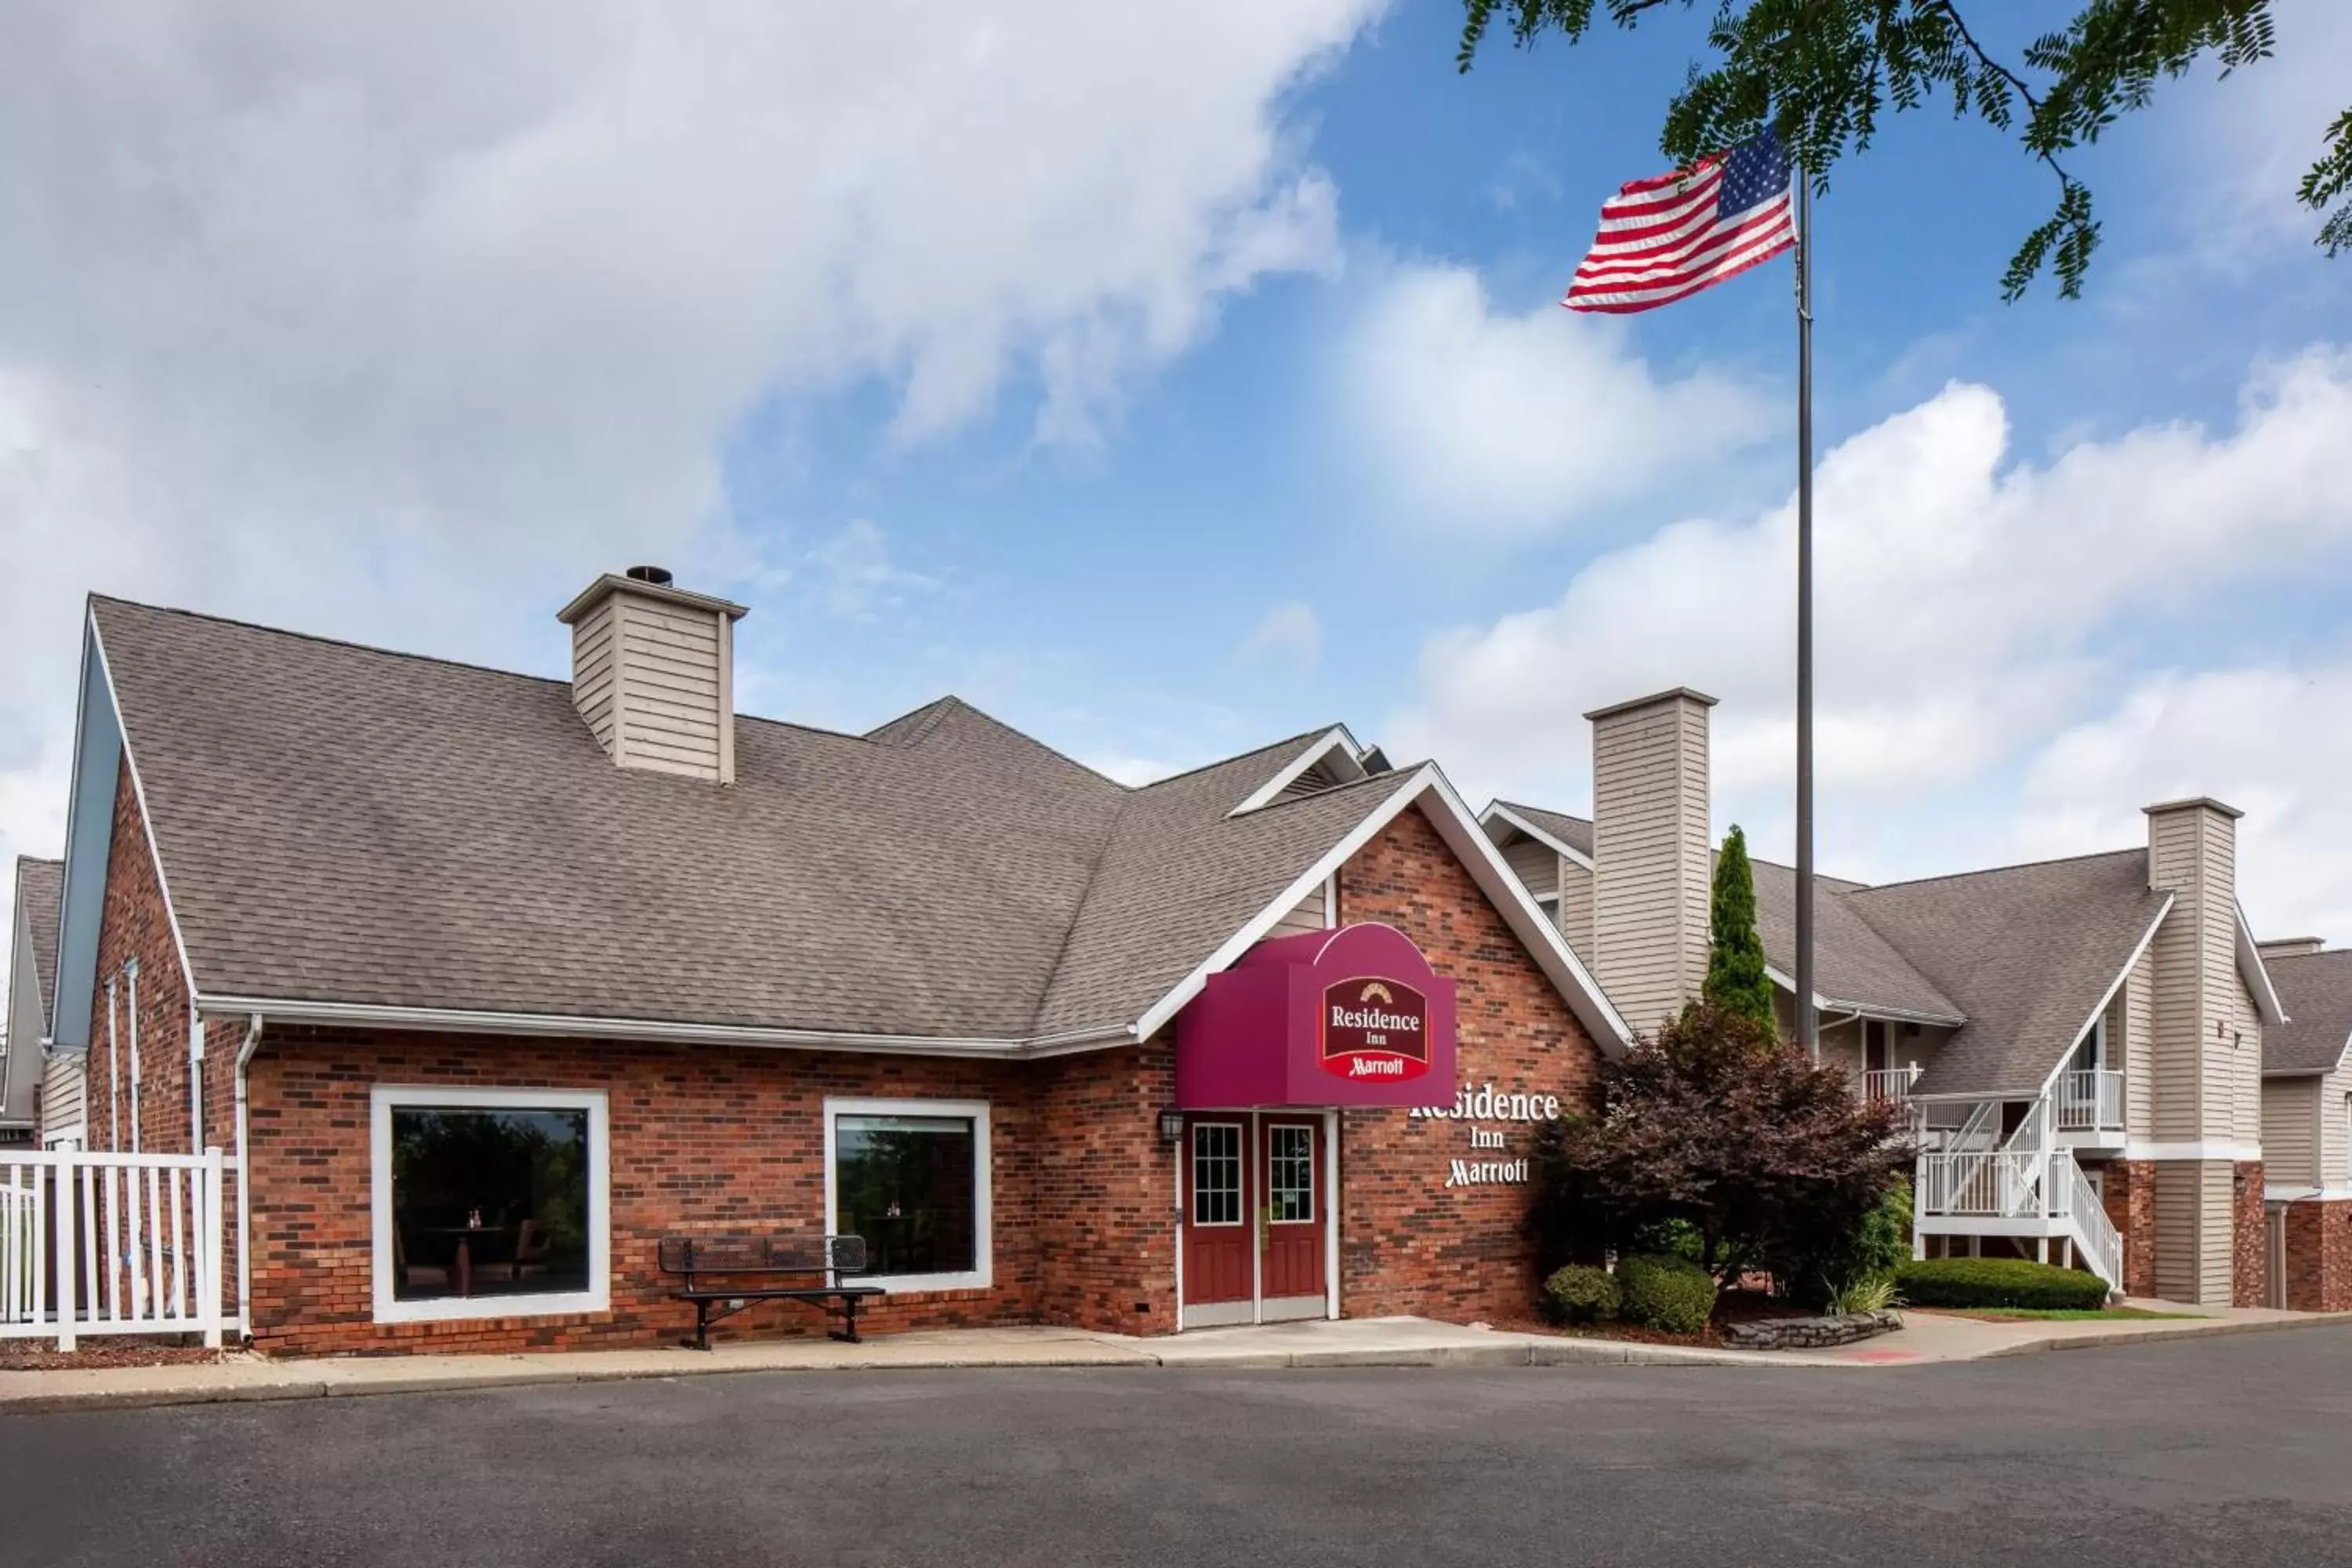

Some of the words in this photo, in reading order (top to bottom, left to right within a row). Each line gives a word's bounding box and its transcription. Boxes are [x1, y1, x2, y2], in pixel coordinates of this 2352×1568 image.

[1331, 1005, 1421, 1031] Residence
[1367, 1031, 1387, 1045] Inn
[1348, 1056, 1404, 1076] Marriott
[1469, 1126, 1504, 1149] Inn
[1444, 1158, 1530, 1188] Marriott
